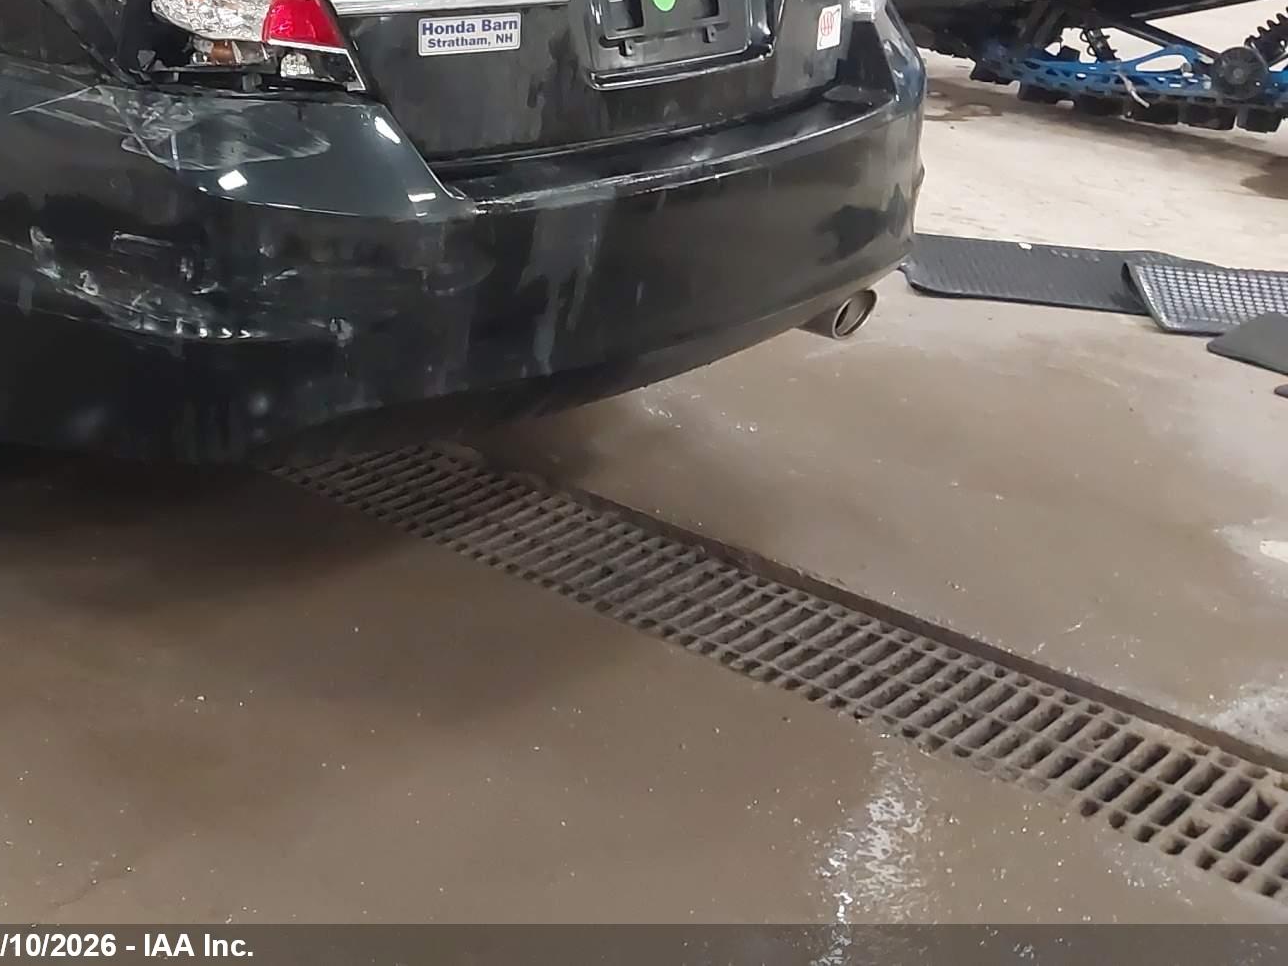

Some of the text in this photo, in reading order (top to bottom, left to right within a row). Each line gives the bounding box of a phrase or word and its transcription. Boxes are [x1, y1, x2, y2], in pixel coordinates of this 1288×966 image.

[422, 19, 518, 36] Honda Barn
[427, 33, 513, 49] Stratham, NH
